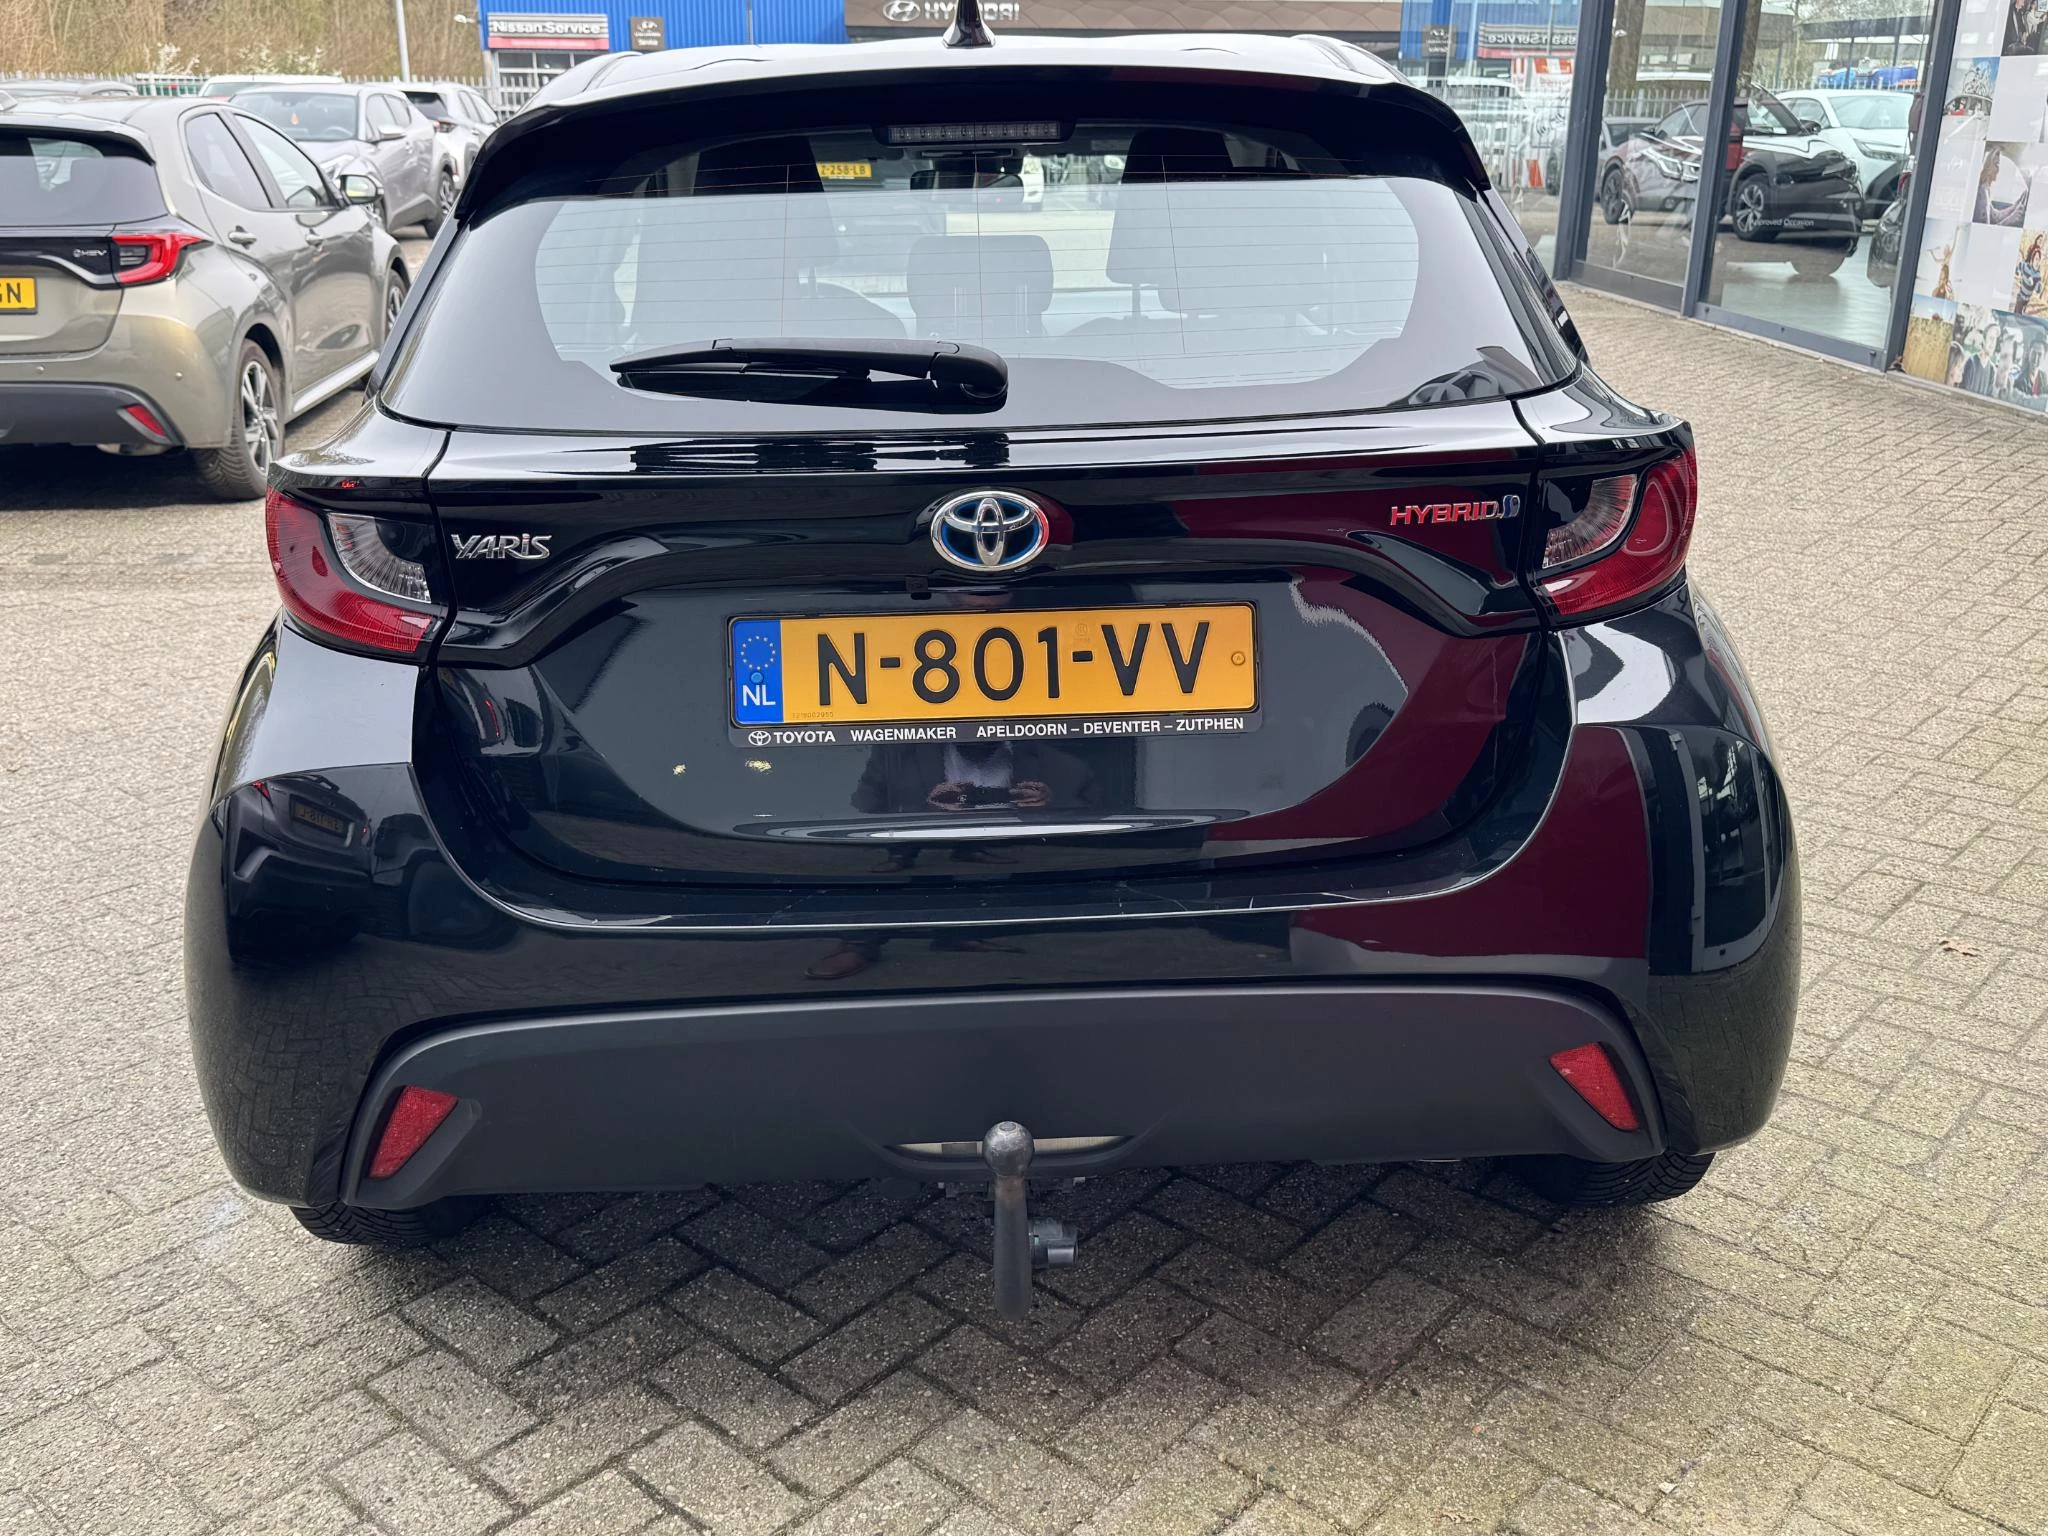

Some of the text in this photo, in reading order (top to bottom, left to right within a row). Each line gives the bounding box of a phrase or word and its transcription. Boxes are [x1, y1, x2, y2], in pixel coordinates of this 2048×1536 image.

[924, 2, 1020, 20] HYDAI
[493, 20, 600, 34] Nissan Service
[0, 282, 21, 303] N
[1390, 501, 1498, 526] HYBRID
[742, 621, 1210, 706] NL N-801-VV
[773, 730, 836, 744] TOYOTA
[851, 726, 957, 742] WAGENMAKER
[976, 723, 1067, 738] APELDOORN
[1083, 720, 1160, 734] DEVENTER
[1176, 717, 1244, 732] ZUTPHEN
